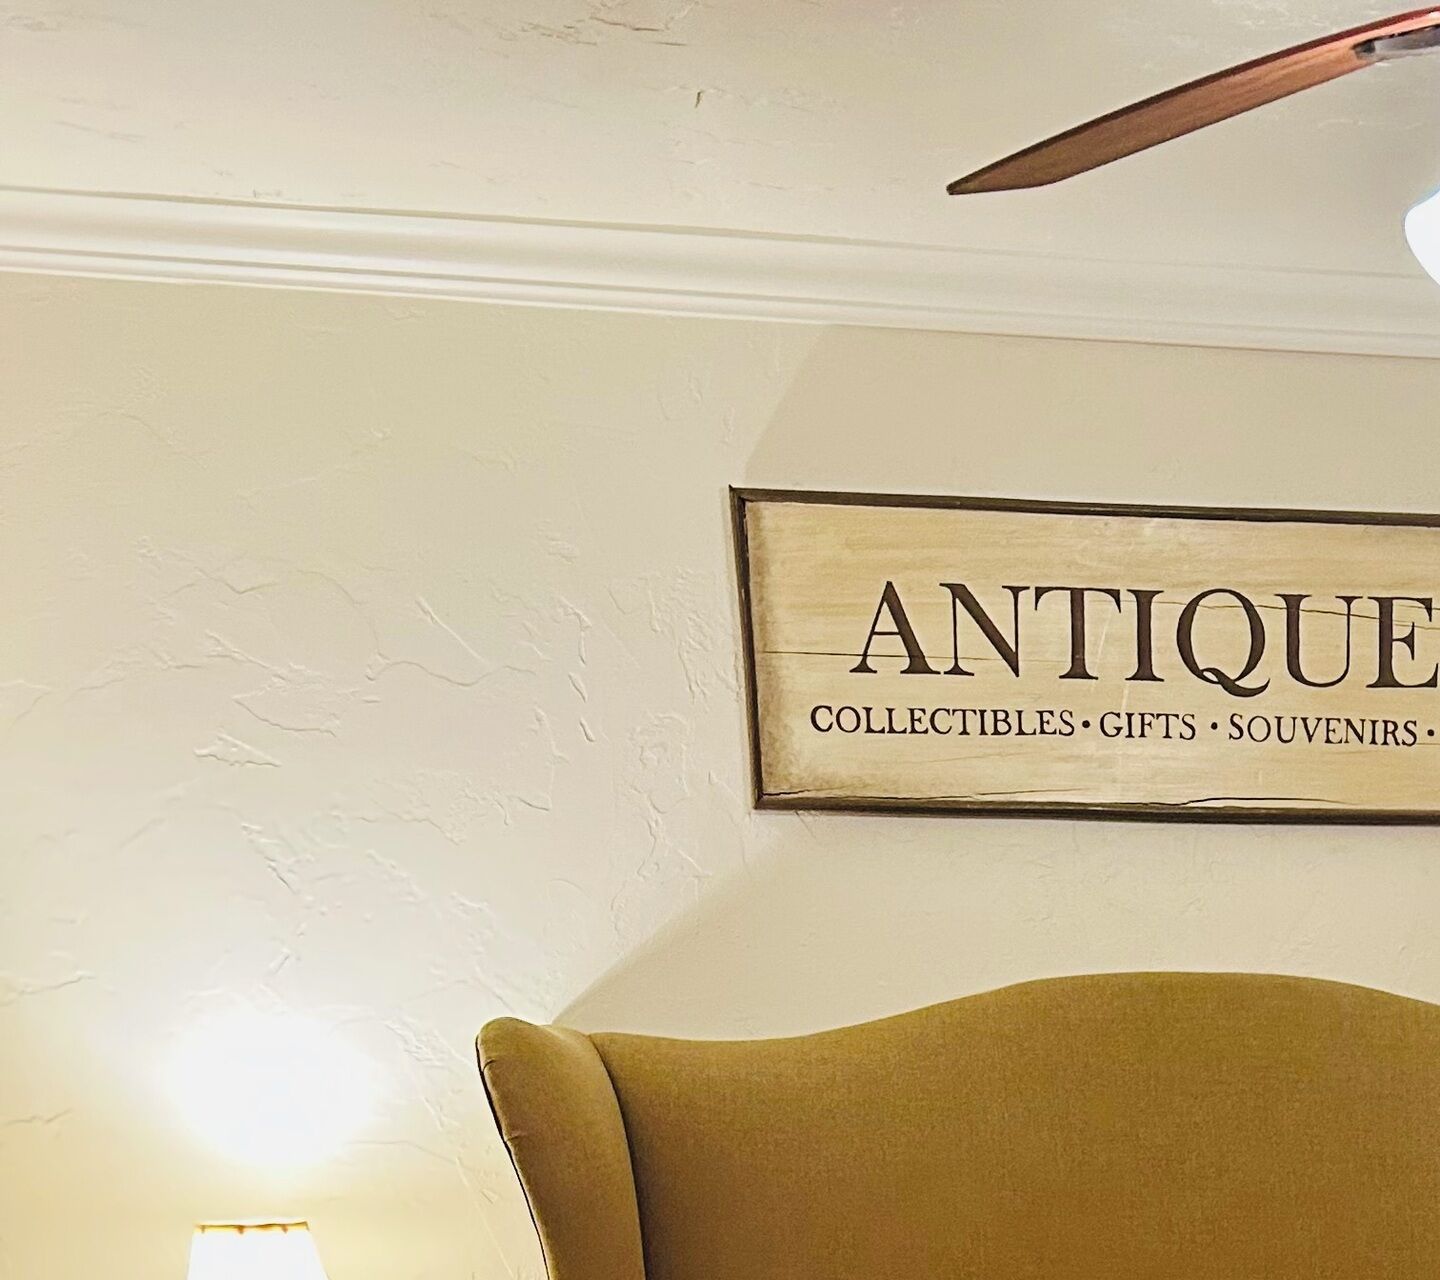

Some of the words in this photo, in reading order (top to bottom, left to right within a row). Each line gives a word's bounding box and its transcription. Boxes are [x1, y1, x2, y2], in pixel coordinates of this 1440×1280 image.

[810, 704, 1075, 737] COLLECTIBLES
[1099, 711, 1197, 741] GIFTS
[1228, 712, 1418, 748] SOUVENIRS
